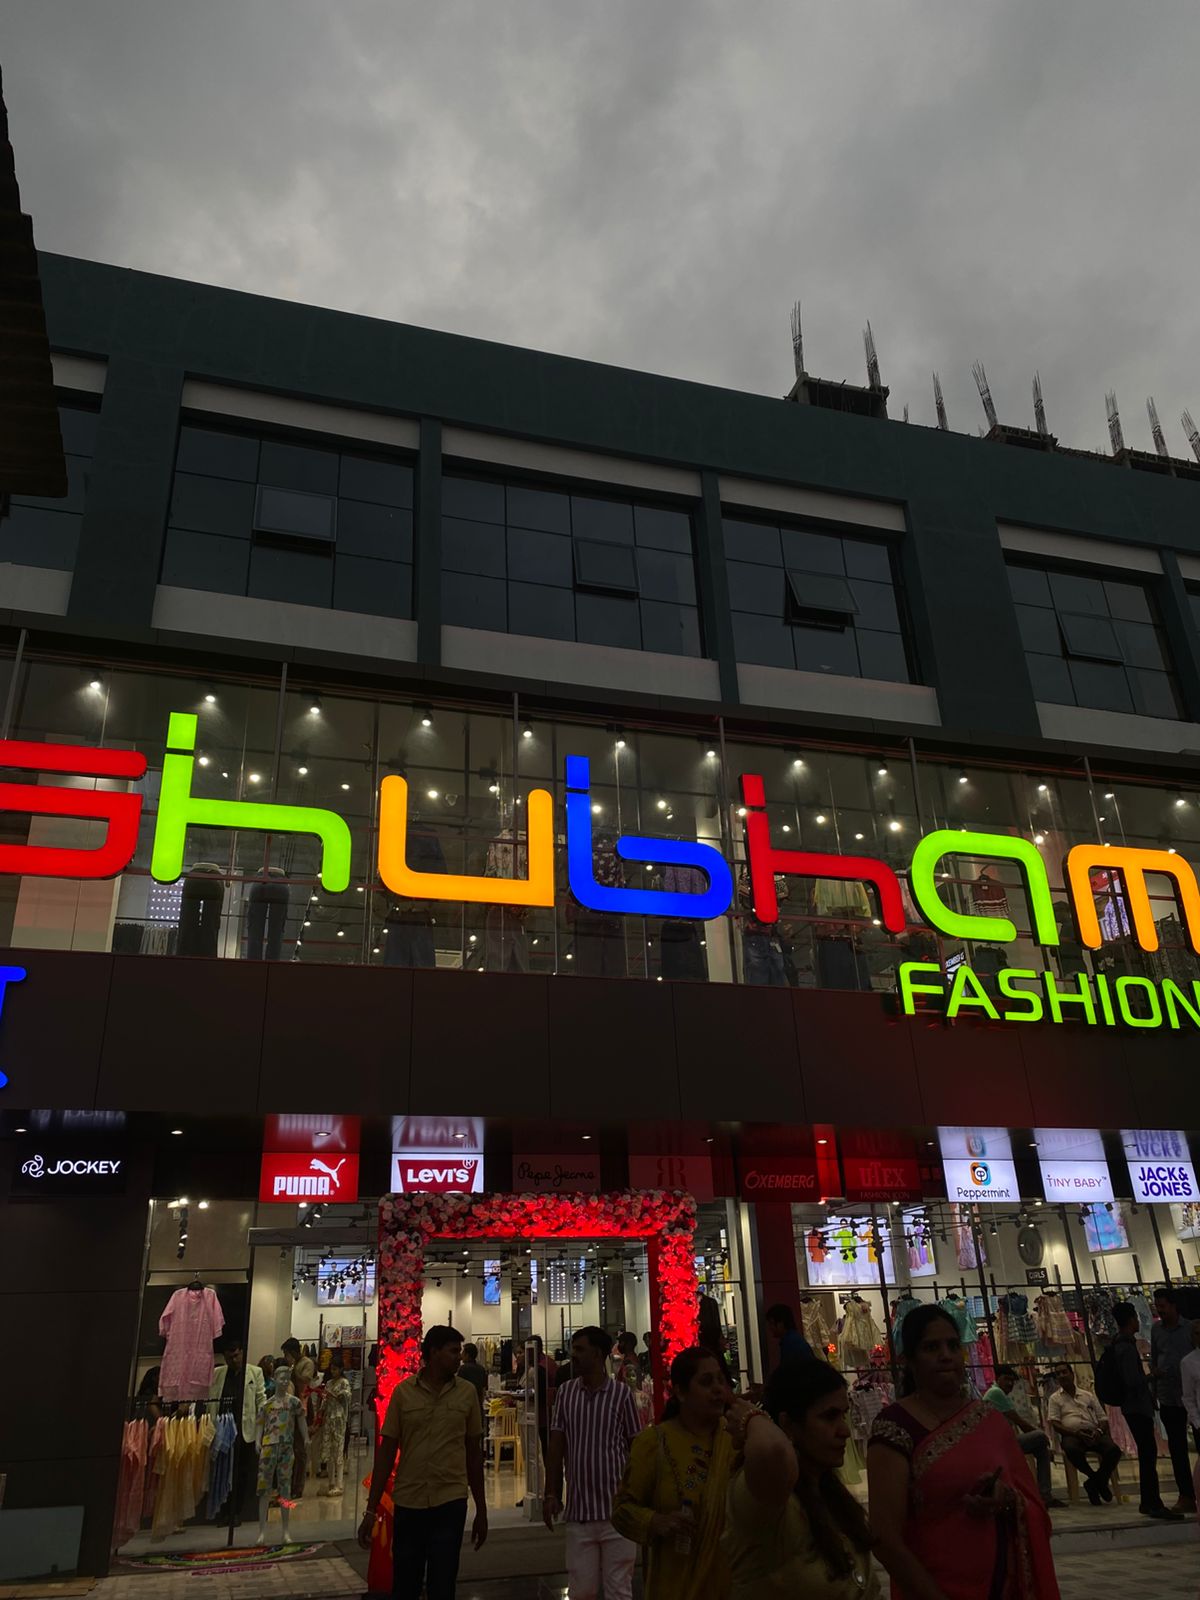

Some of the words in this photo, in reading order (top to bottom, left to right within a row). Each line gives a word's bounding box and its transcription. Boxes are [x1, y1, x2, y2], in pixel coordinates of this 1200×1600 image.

[518, 1162, 551, 1186] Pepe
[744, 1169, 816, 1190] OXEMBERG
[1046, 1175, 1071, 1188] TINY
[273, 1176, 331, 1196] PUMA
[957, 1187, 1011, 1199] Peppermint
[1142, 1182, 1192, 1196] JONES
